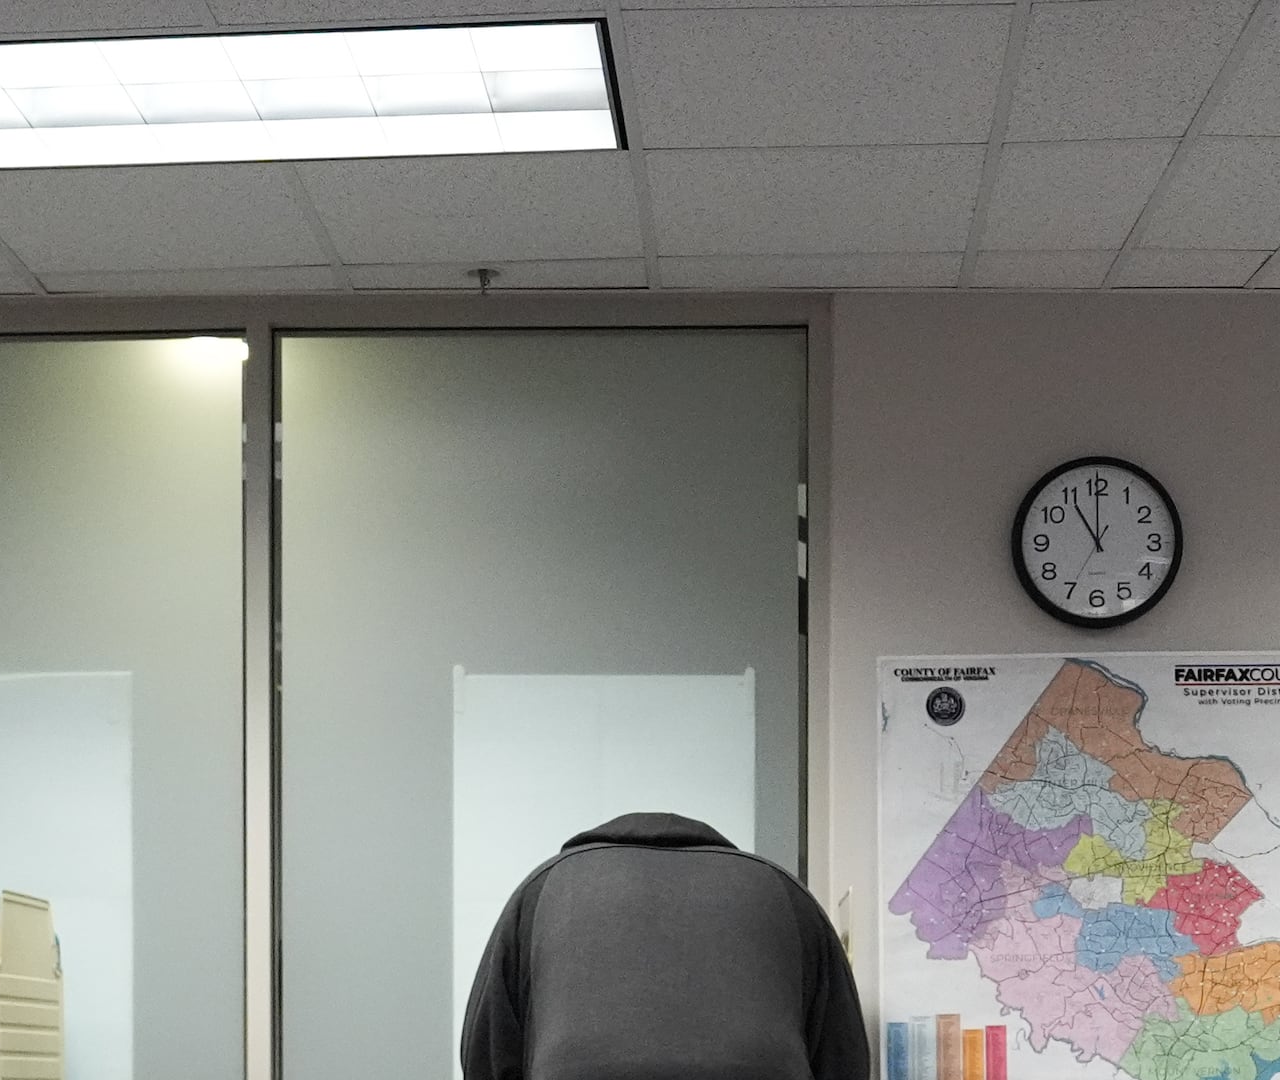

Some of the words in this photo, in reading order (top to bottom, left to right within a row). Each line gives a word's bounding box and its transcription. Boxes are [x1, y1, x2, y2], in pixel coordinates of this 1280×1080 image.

[1062, 486, 1078, 504] 11
[1086, 478, 1108, 496] 12
[1122, 486, 1130, 504] 1
[1041, 505, 1065, 524] 10
[1137, 505, 1152, 524] 2
[1033, 534, 1050, 552] 9
[1146, 533, 1162, 552] 3
[1041, 562, 1057, 580] 8
[1138, 562, 1153, 580] 4
[1064, 582, 1078, 600] 7
[1088, 589, 1106, 608] 6
[1116, 582, 1132, 600] 5
[894, 668, 935, 676] COUNTY
[938, 667, 950, 676] OF
[954, 666, 996, 676] FAIRFAX
[1184, 687, 1252, 698] Supervisor
[1220, 698, 1251, 706] Voting
